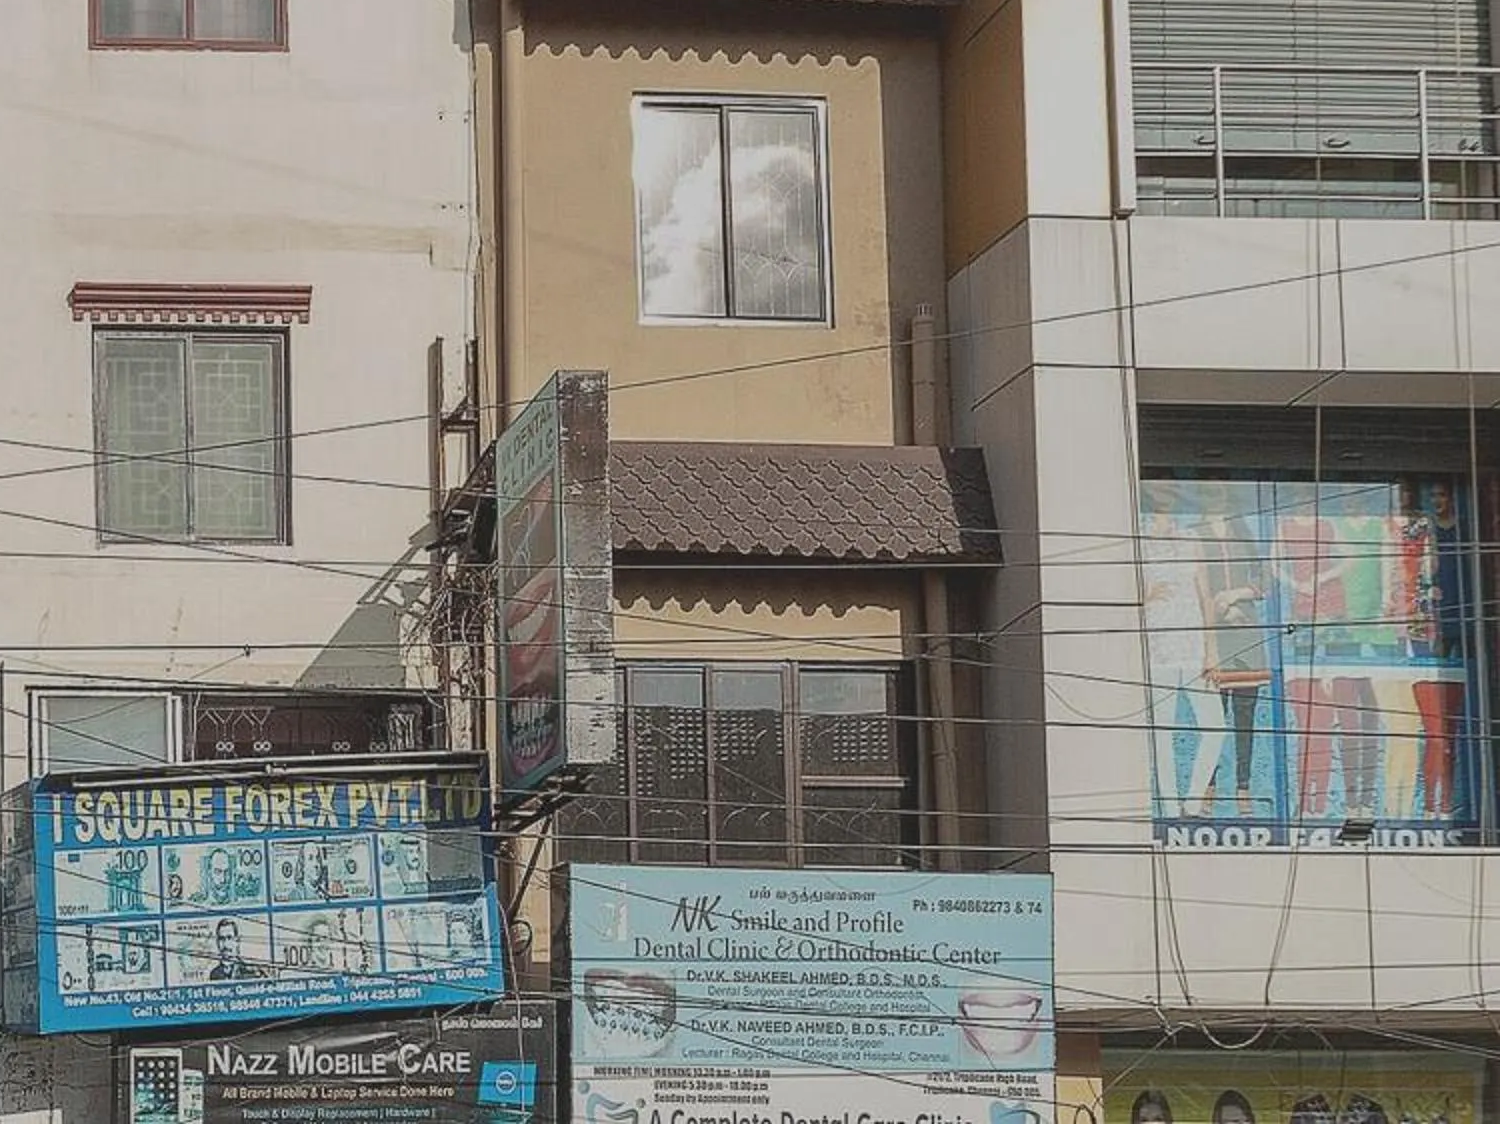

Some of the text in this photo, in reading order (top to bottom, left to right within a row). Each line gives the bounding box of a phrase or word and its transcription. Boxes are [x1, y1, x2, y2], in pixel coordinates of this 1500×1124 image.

[501, 428, 555, 495] CLINIC
[52, 792, 64, 844] I
[74, 786, 216, 845] SQUARE
[226, 781, 338, 833] FOREX
[1167, 827, 1271, 847] NOOR
[116, 849, 148, 872] 100
[238, 849, 263, 867] 100
[671, 895, 905, 934] NK Smile and Profile
[912, 899, 930, 912] Ph
[1013, 902, 1024, 914] &
[1027, 902, 1043, 914] 74
[633, 935, 1002, 965] Dental Clinic & Orthodontic Center
[732, 970, 798, 985] SHAKEEL
[737, 1020, 793, 1033] NAVEED
[751, 1035, 885, 1050] Consultant Dental Surgeon
[222, 1084, 455, 1101] All Brand Mobile & Laptop Service Done Here
[653, 1093, 685, 1104] Sunday
[242, 1107, 270, 1120] Touch
[384, 1106, 431, 1119] Hardware
